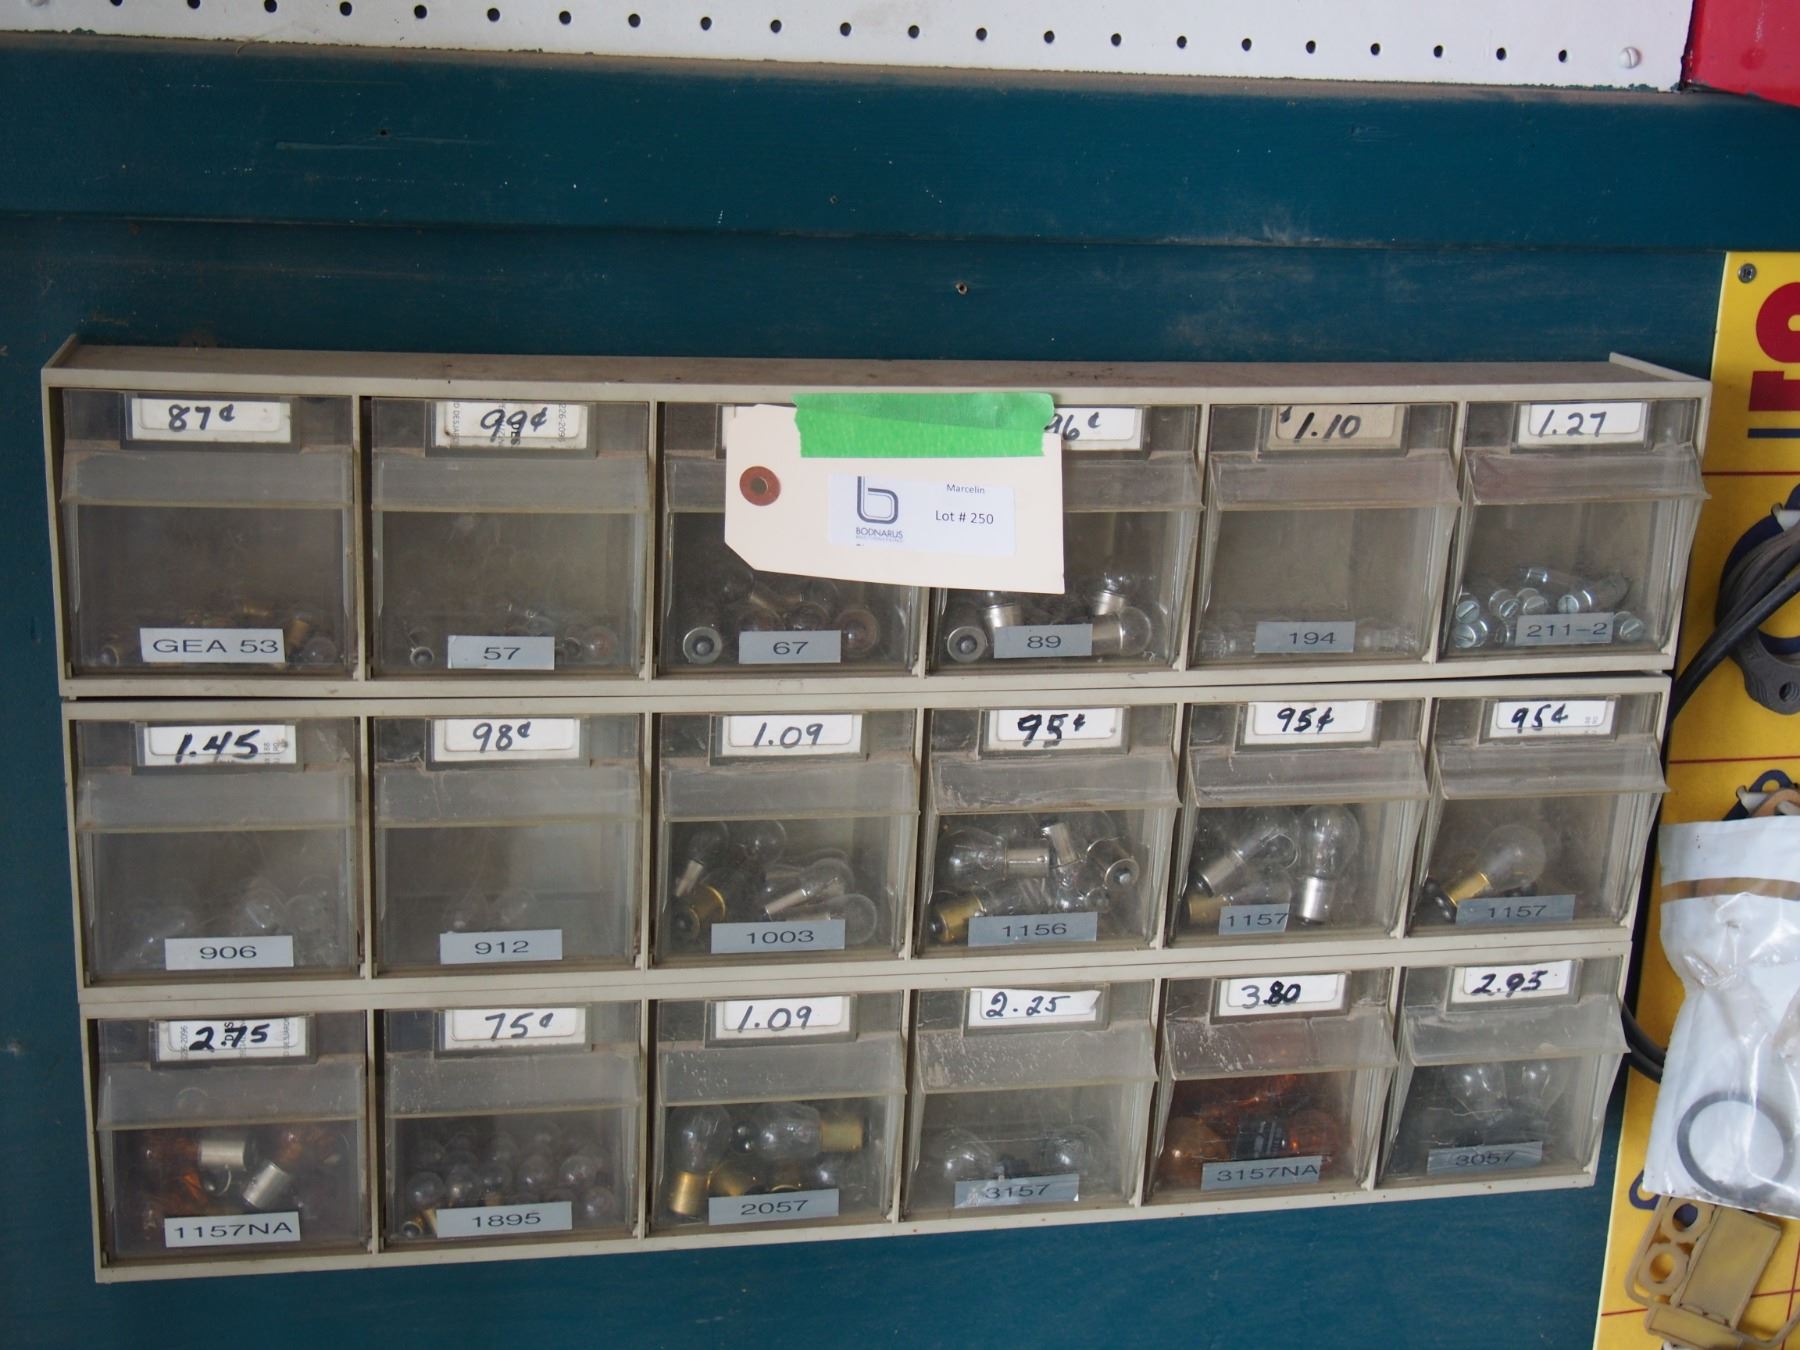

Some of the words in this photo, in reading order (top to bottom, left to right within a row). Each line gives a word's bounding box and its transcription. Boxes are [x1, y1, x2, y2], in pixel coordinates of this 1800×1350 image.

[479, 406, 548, 443] 99¢
[1537, 408, 1608, 438] 1.27
[946, 483, 986, 495] Marcelin
[935, 510, 954, 522] Lot
[959, 511, 966, 522] #
[970, 512, 994, 525] 250
[855, 526, 904, 541] BODNARUS
[1526, 622, 1609, 638] 211-2
[152, 639, 228, 654] GEA
[240, 639, 280, 654] 53
[1026, 634, 1063, 650] 89
[1288, 631, 1337, 646] 194
[483, 646, 521, 661] 57
[772, 640, 809, 656] 67
[1276, 706, 1335, 734] 95¢
[1511, 703, 1569, 734] 95¢
[753, 721, 824, 750] 1.09
[175, 728, 261, 764] 1.45
[1487, 903, 1547, 919] 1157
[1225, 912, 1289, 928] 1157
[745, 929, 815, 945] 1003
[1001, 923, 1068, 938] 1156
[198, 944, 258, 960] 906
[474, 939, 530, 955] 912
[1470, 969, 1549, 998] 2.95
[985, 990, 1070, 1018] 2.25
[737, 1005, 813, 1033] 1.09
[188, 1023, 271, 1053] 2.75
[1454, 1150, 1516, 1167] 3057
[1216, 1163, 1318, 1182] 3157NA
[984, 1183, 1051, 1199] 3157
[740, 1199, 809, 1216] 2057
[471, 1211, 542, 1229] 1895
[172, 1220, 294, 1240] 1157NA
